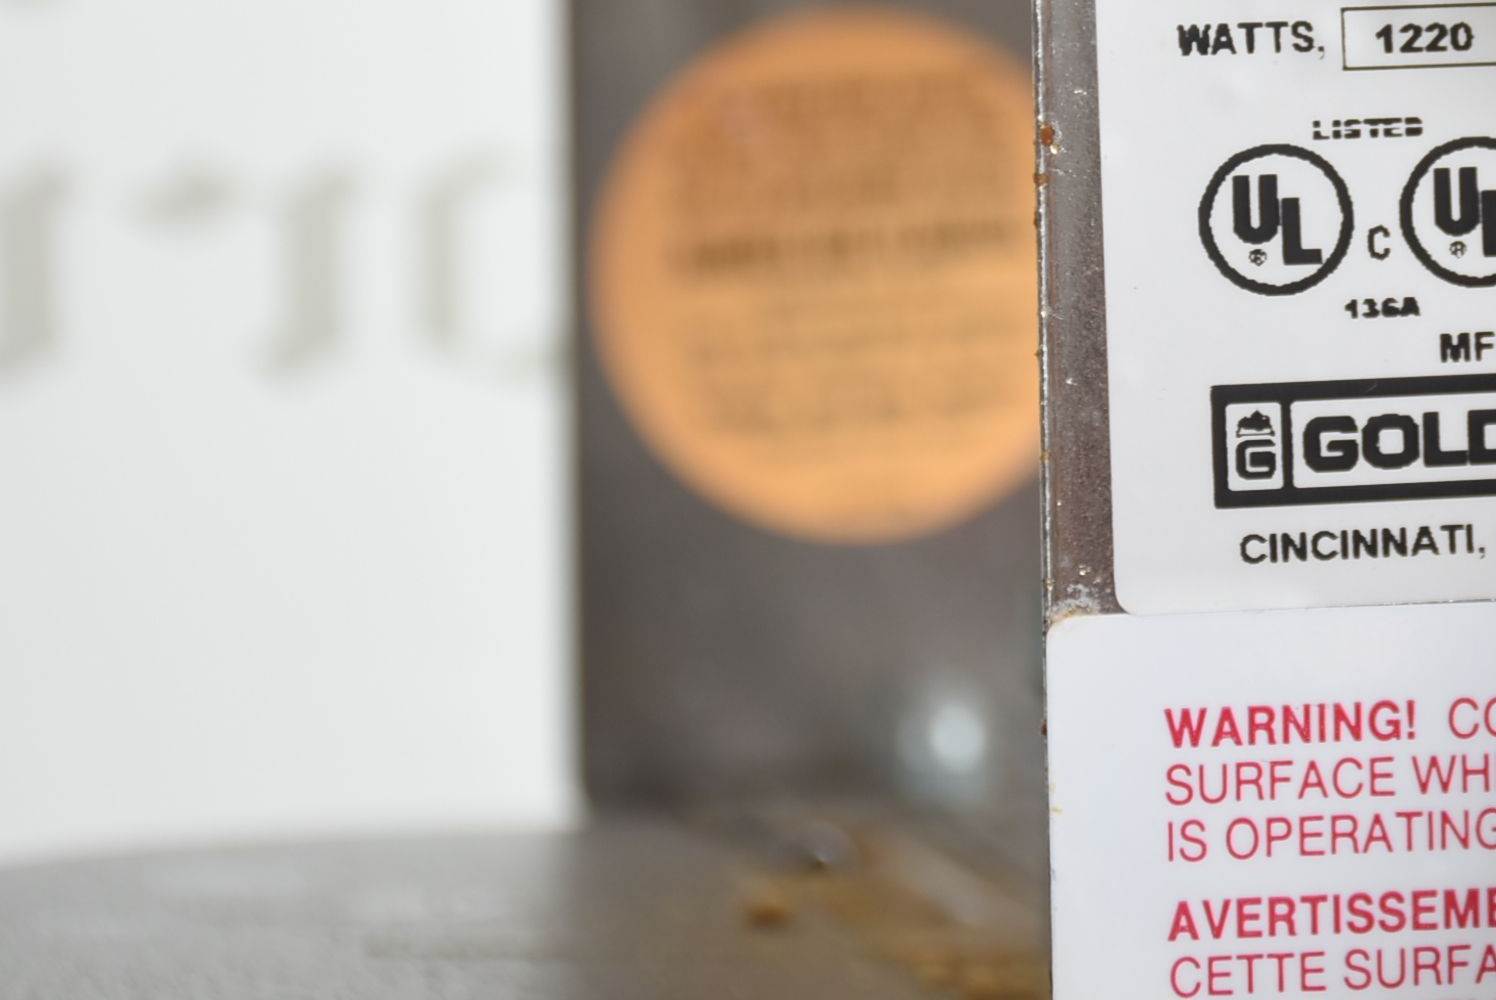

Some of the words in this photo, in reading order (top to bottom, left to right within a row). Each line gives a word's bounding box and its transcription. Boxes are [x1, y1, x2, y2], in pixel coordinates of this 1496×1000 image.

[1374, 21, 1475, 55] 1220
[1311, 116, 1424, 141] LISTED
[1231, 173, 1323, 266] UL
[1343, 296, 1422, 320] 136A
[1239, 523, 1487, 566] CINCINNATI,
[1163, 698, 1418, 750] WARNING!
[1165, 754, 1397, 807] SURFACE
[1167, 817, 1210, 863] IS
[1169, 951, 1329, 1000] CETTE
